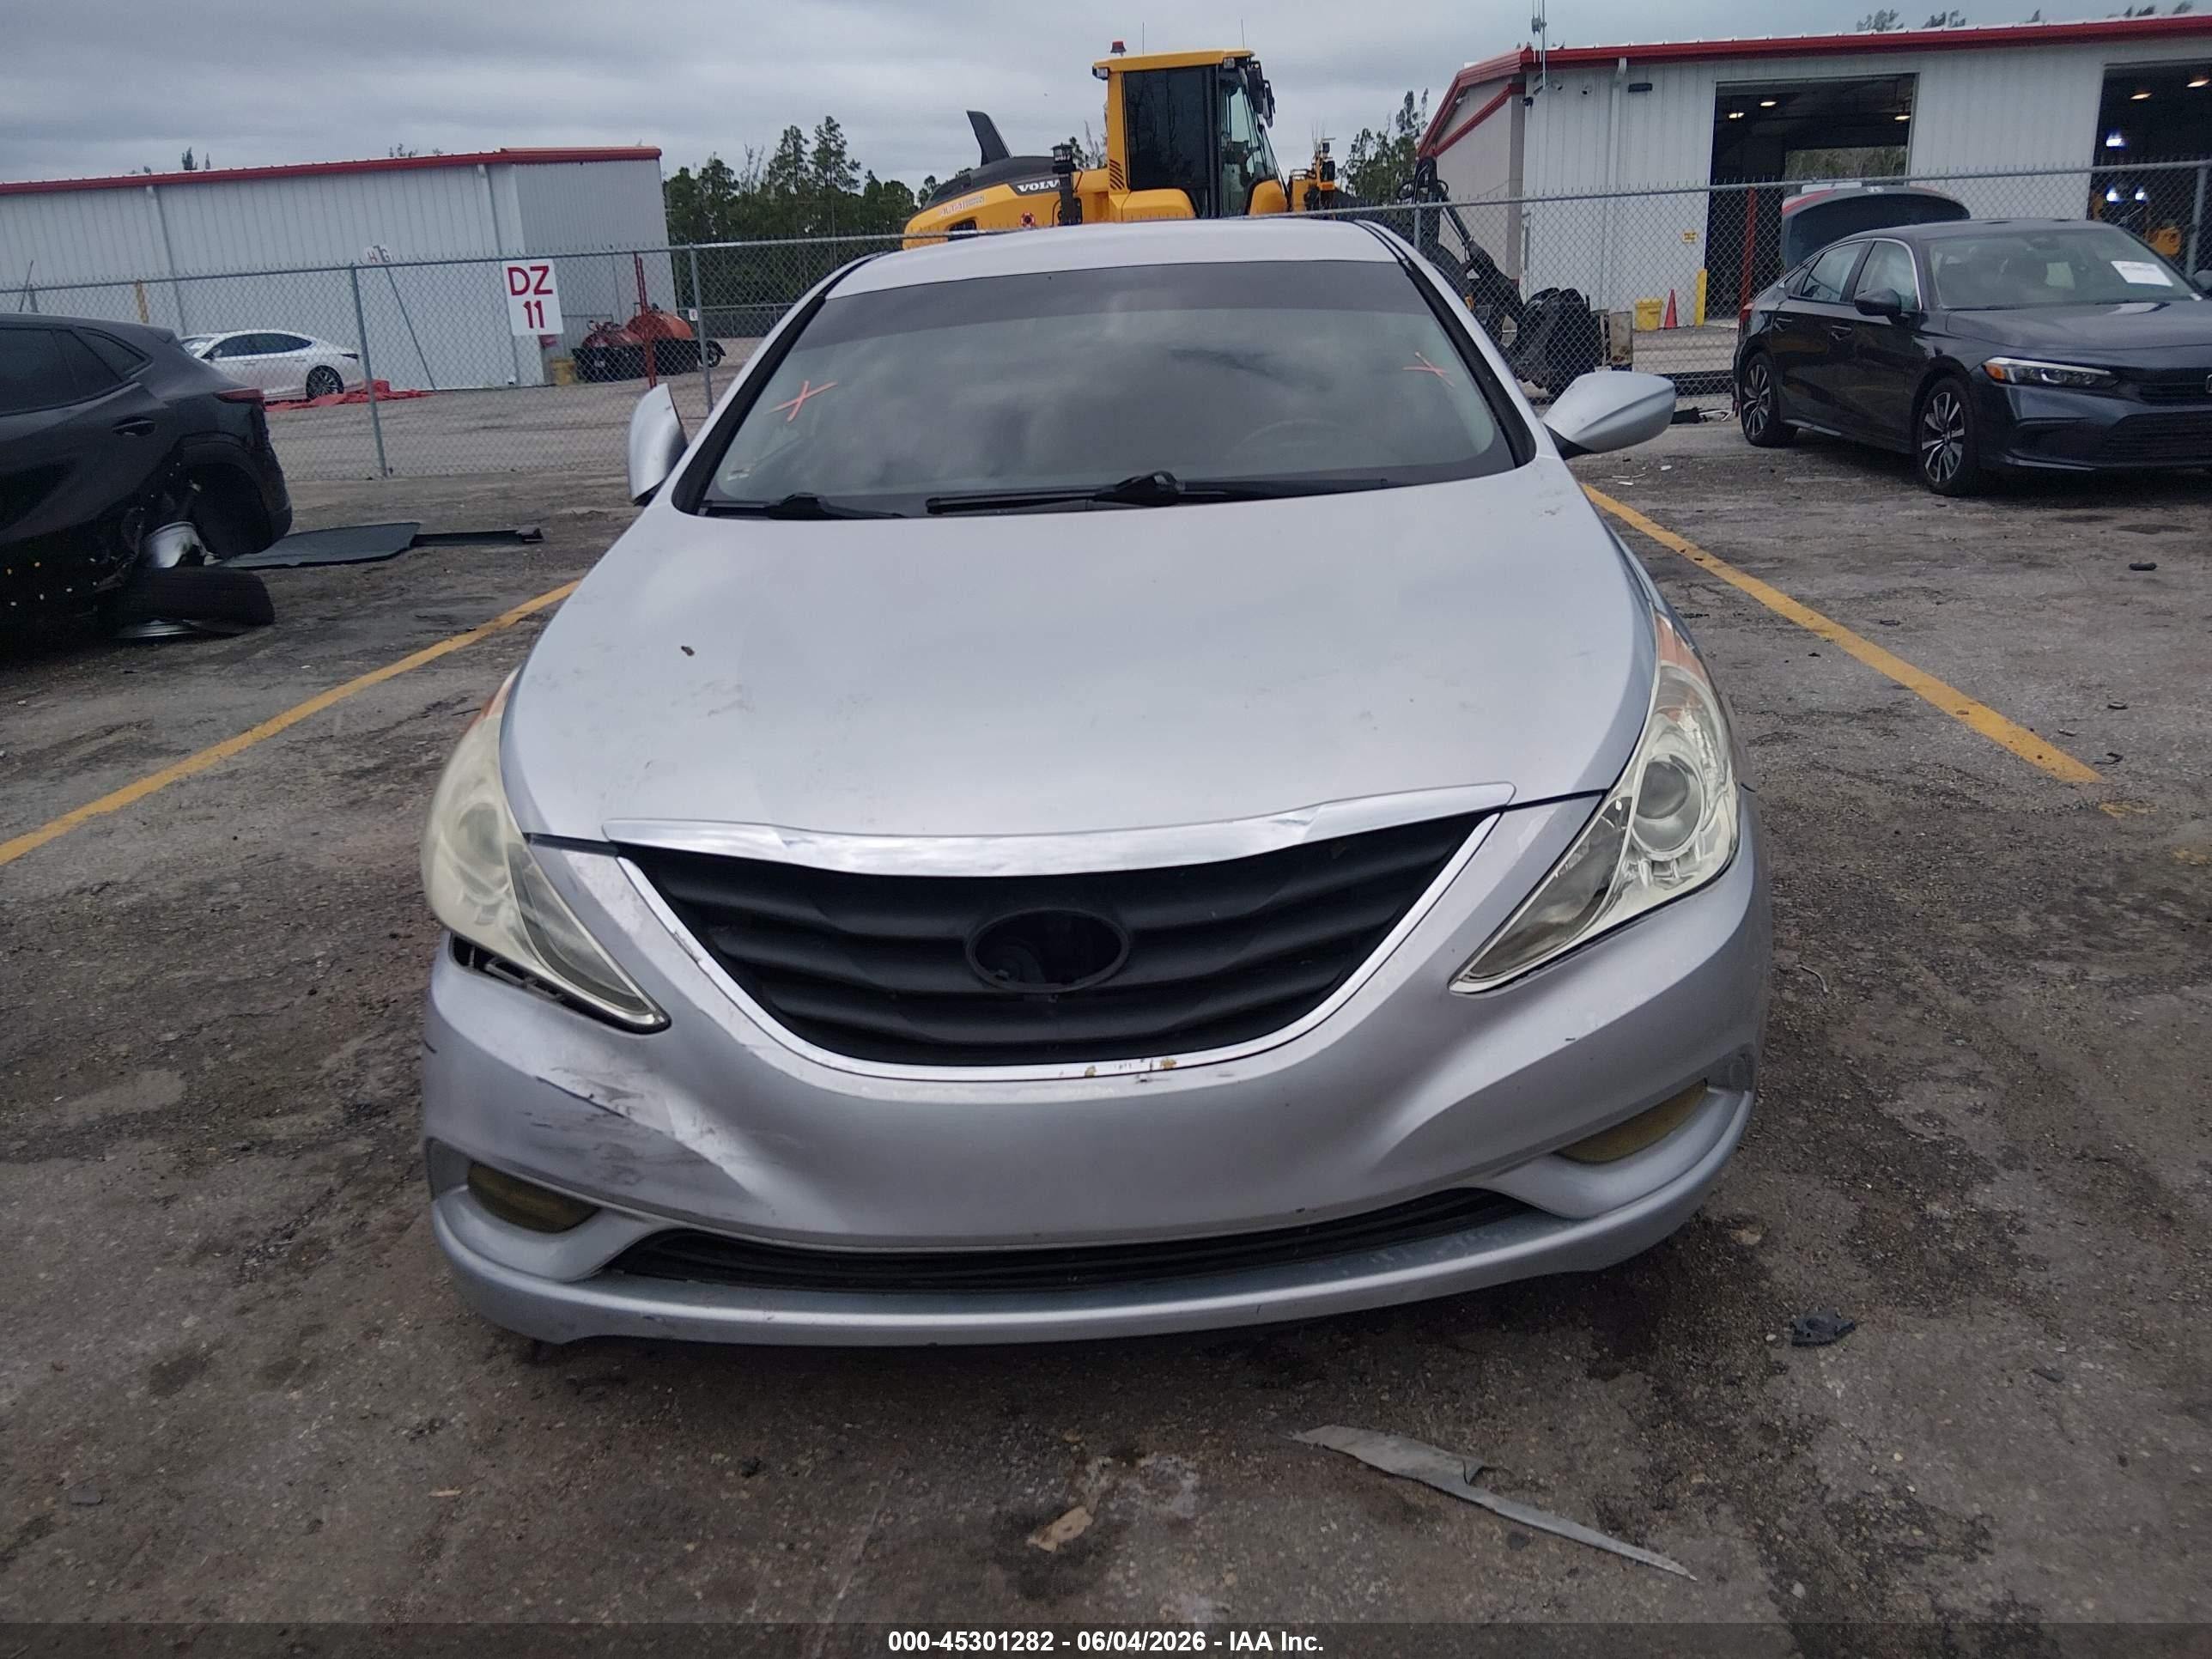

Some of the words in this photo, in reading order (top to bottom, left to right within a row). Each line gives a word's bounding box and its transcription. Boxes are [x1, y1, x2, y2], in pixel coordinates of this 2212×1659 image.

[1018, 179, 1060, 192] VOLV
[507, 265, 554, 295] DZ
[523, 301, 544, 329] 11
